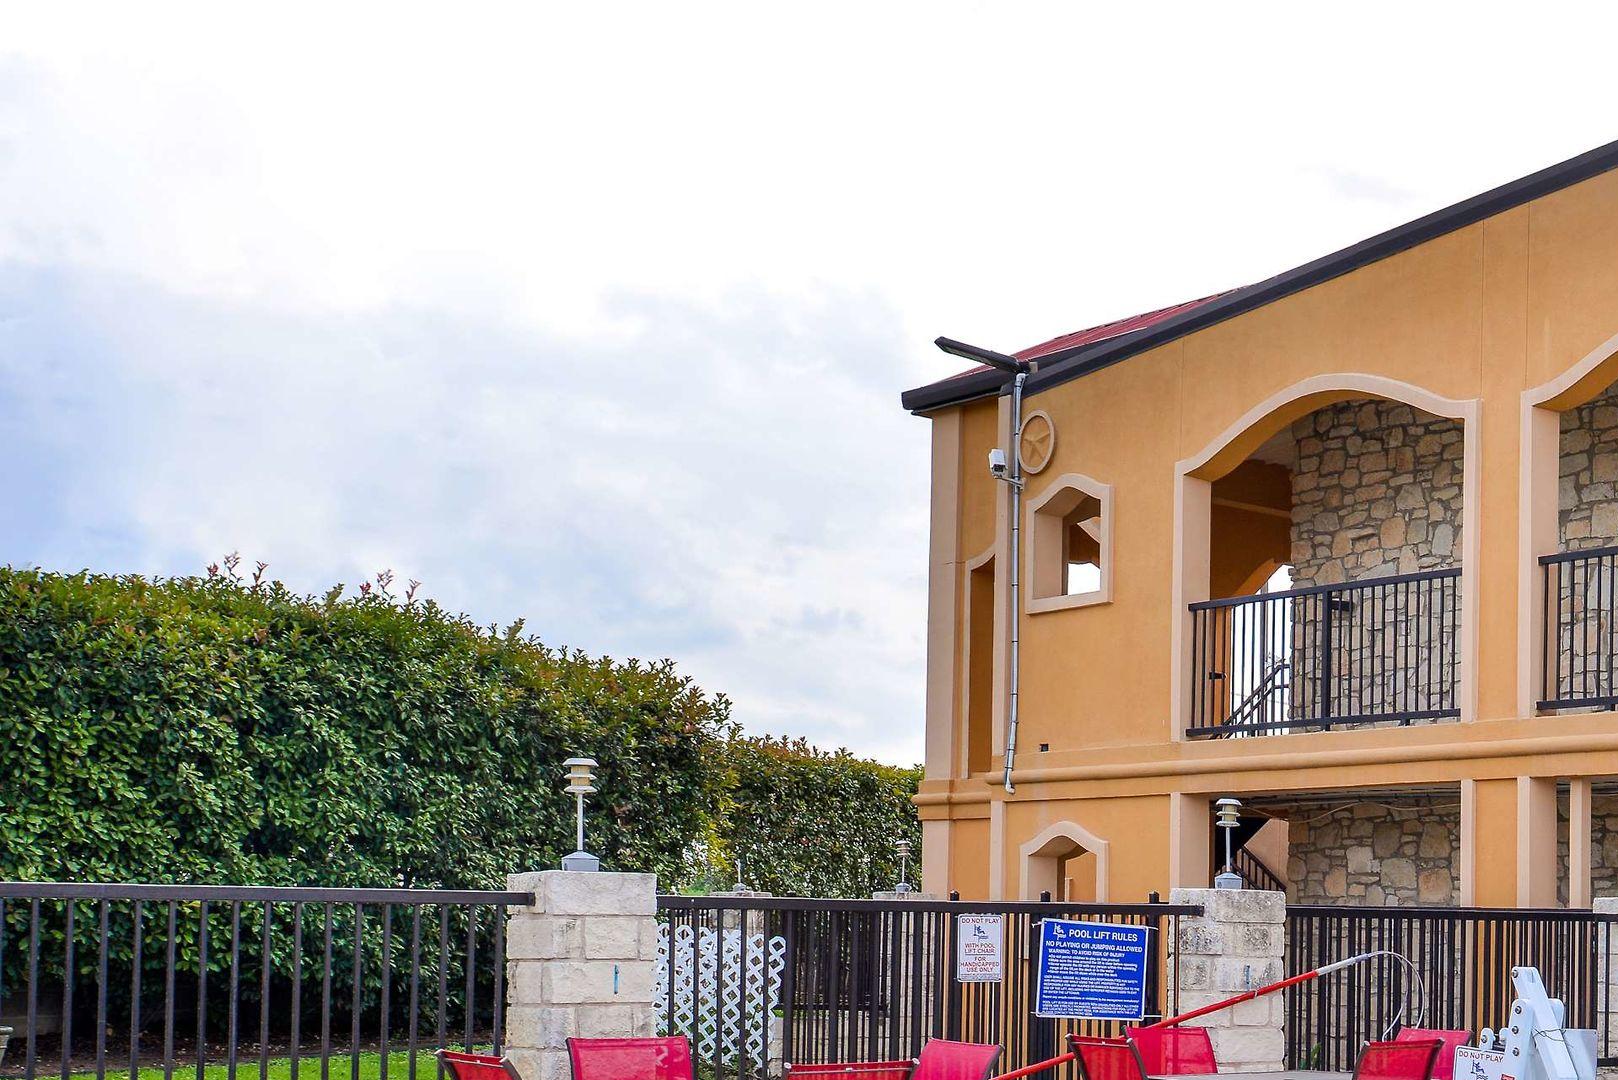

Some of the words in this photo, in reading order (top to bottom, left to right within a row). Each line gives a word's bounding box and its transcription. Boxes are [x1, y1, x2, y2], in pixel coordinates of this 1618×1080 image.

[1068, 929, 1092, 939] POOL
[1094, 931, 1110, 940] LIFT
[1112, 932, 1138, 942] RULES
[1470, 1052, 1484, 1060] NOT
[1486, 1054, 1504, 1063] PLAY
